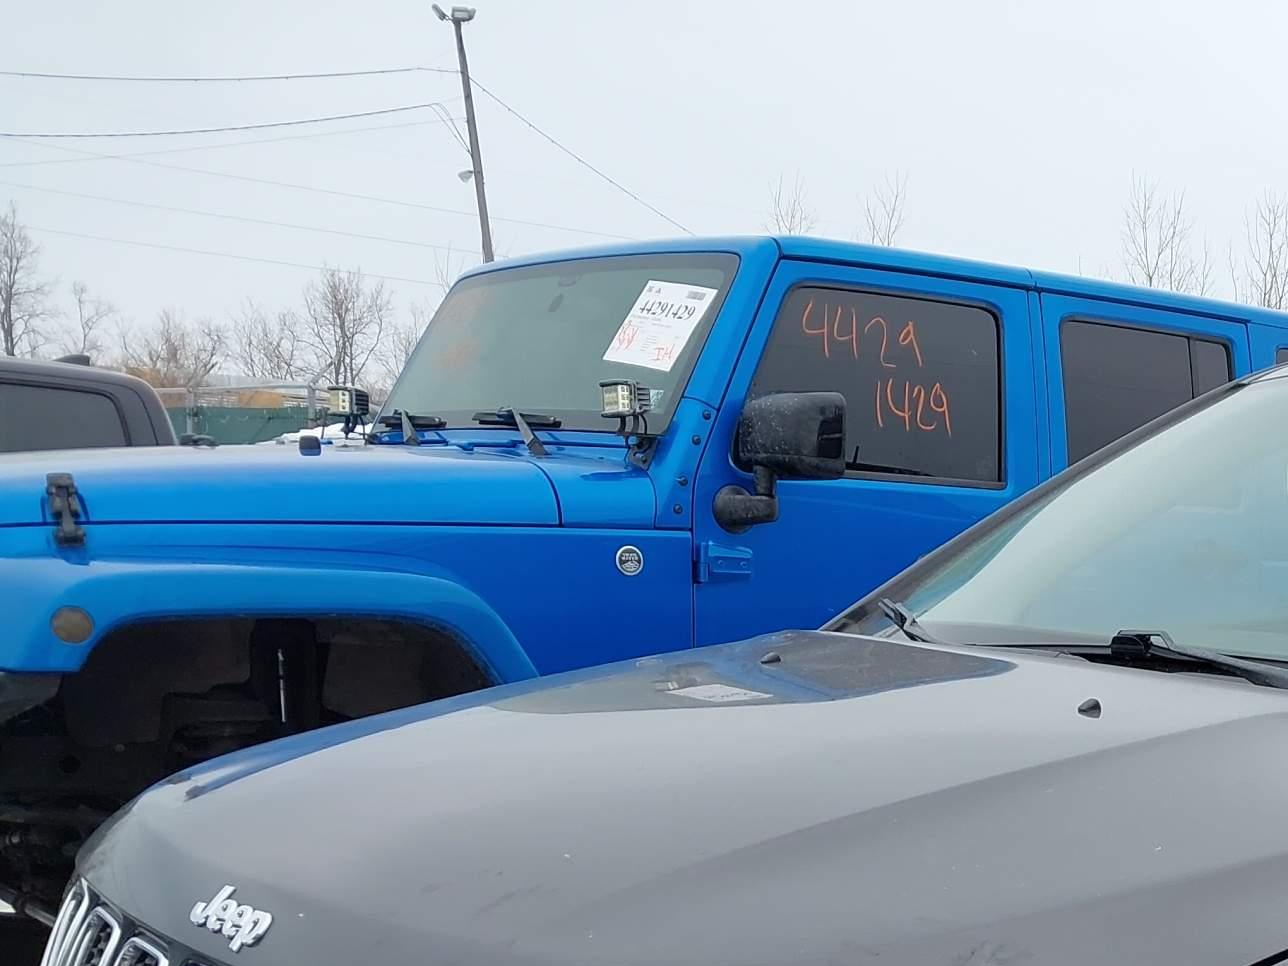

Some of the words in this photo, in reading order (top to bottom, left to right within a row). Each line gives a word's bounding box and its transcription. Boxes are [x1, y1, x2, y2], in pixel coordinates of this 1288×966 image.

[639, 299, 697, 321] 44291429
[802, 299, 923, 368] 4429
[875, 377, 952, 438] 1429
[189, 884, 273, 953] Jeep
